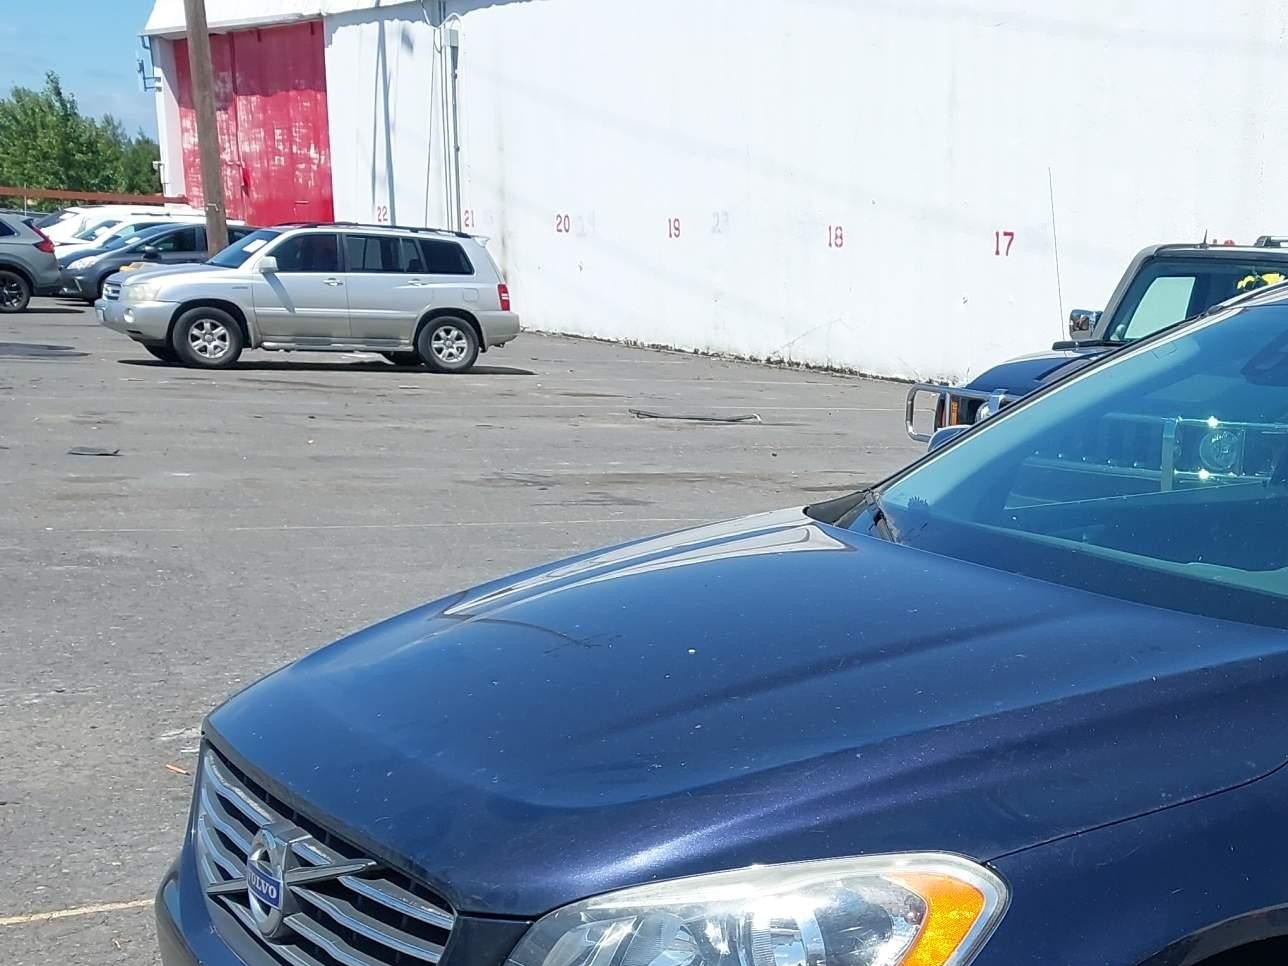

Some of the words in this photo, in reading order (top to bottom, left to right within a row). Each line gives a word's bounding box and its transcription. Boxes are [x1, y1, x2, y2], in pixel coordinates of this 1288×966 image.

[555, 213, 571, 233] 20
[667, 217, 681, 239] 19
[828, 225, 845, 249] 18
[994, 230, 1016, 257] 17
